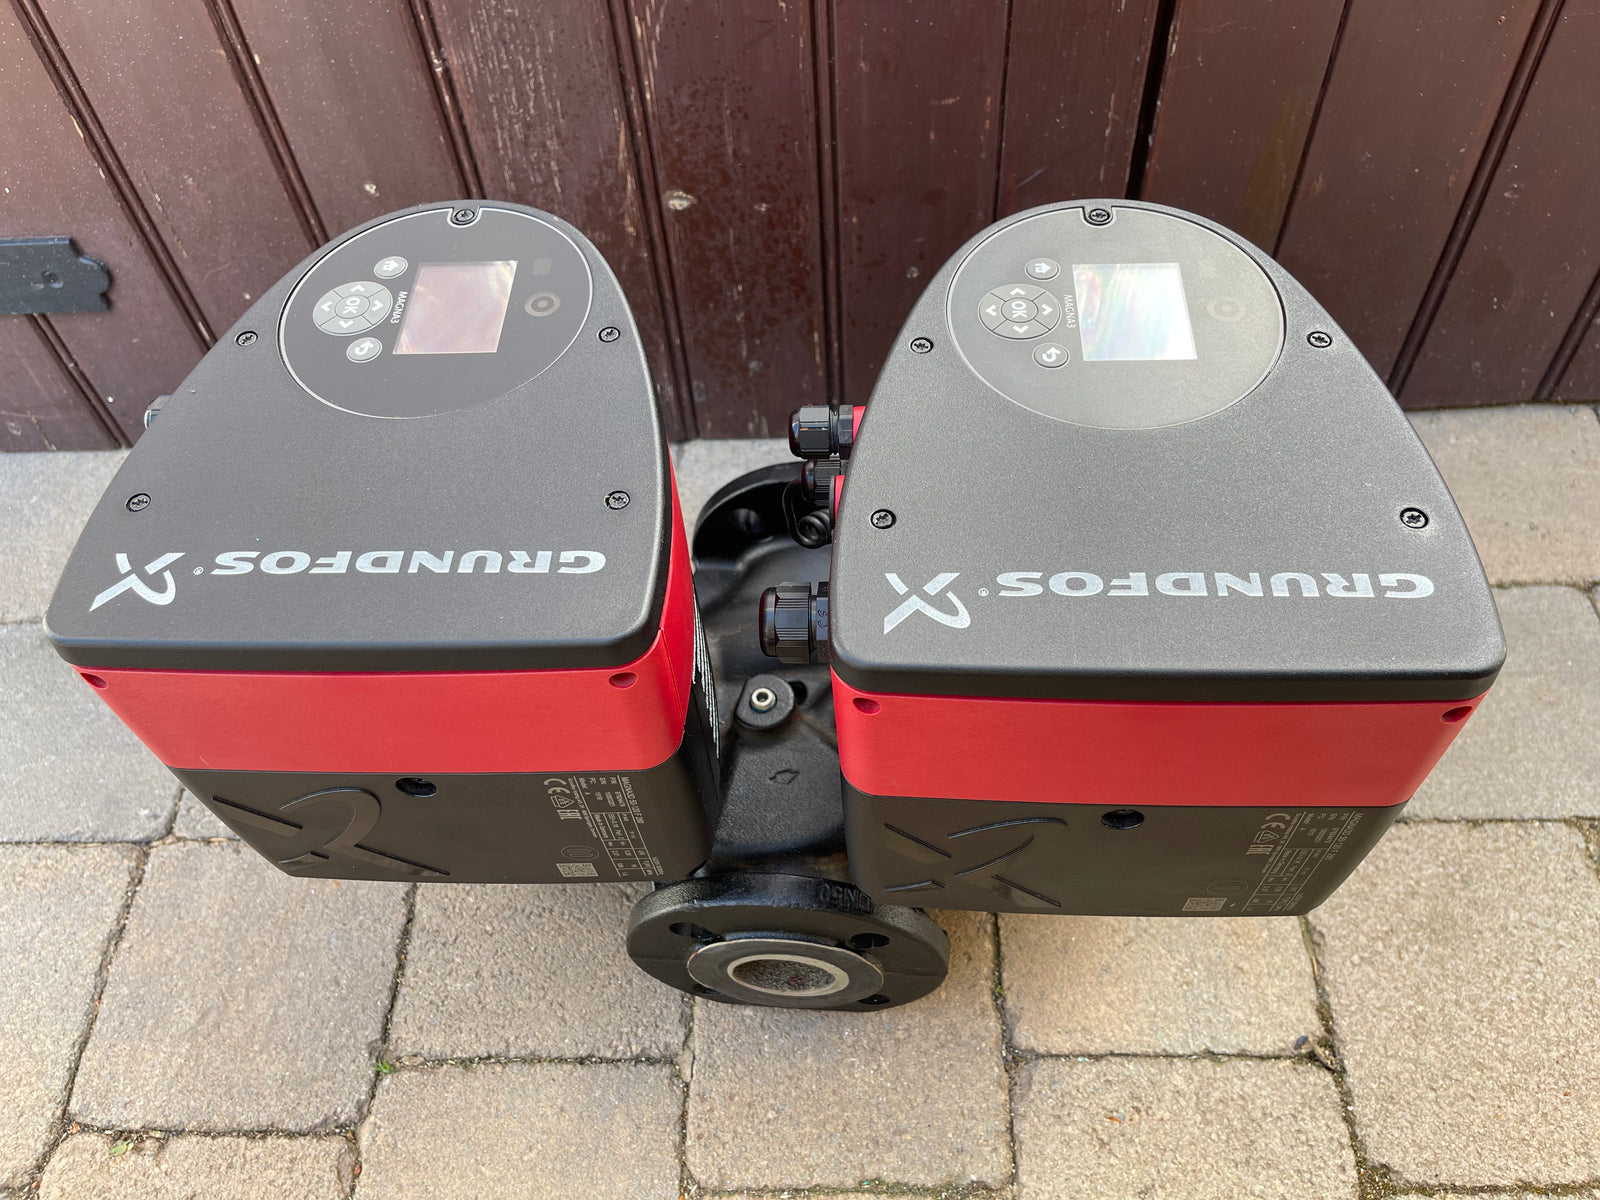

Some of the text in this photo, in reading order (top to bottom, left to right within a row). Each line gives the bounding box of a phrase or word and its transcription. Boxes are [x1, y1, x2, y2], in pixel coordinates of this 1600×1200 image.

[343, 297, 360, 314] OK
[390, 291, 408, 324] MAGNA3
[1011, 301, 1027, 319] OK
[1063, 294, 1076, 328] MAGNA3
[210, 551, 607, 575] GRUNDFOS
[996, 571, 1435, 599] GRUNDFOS
[543, 778, 571, 794] CE
[1260, 813, 1291, 829] CE
